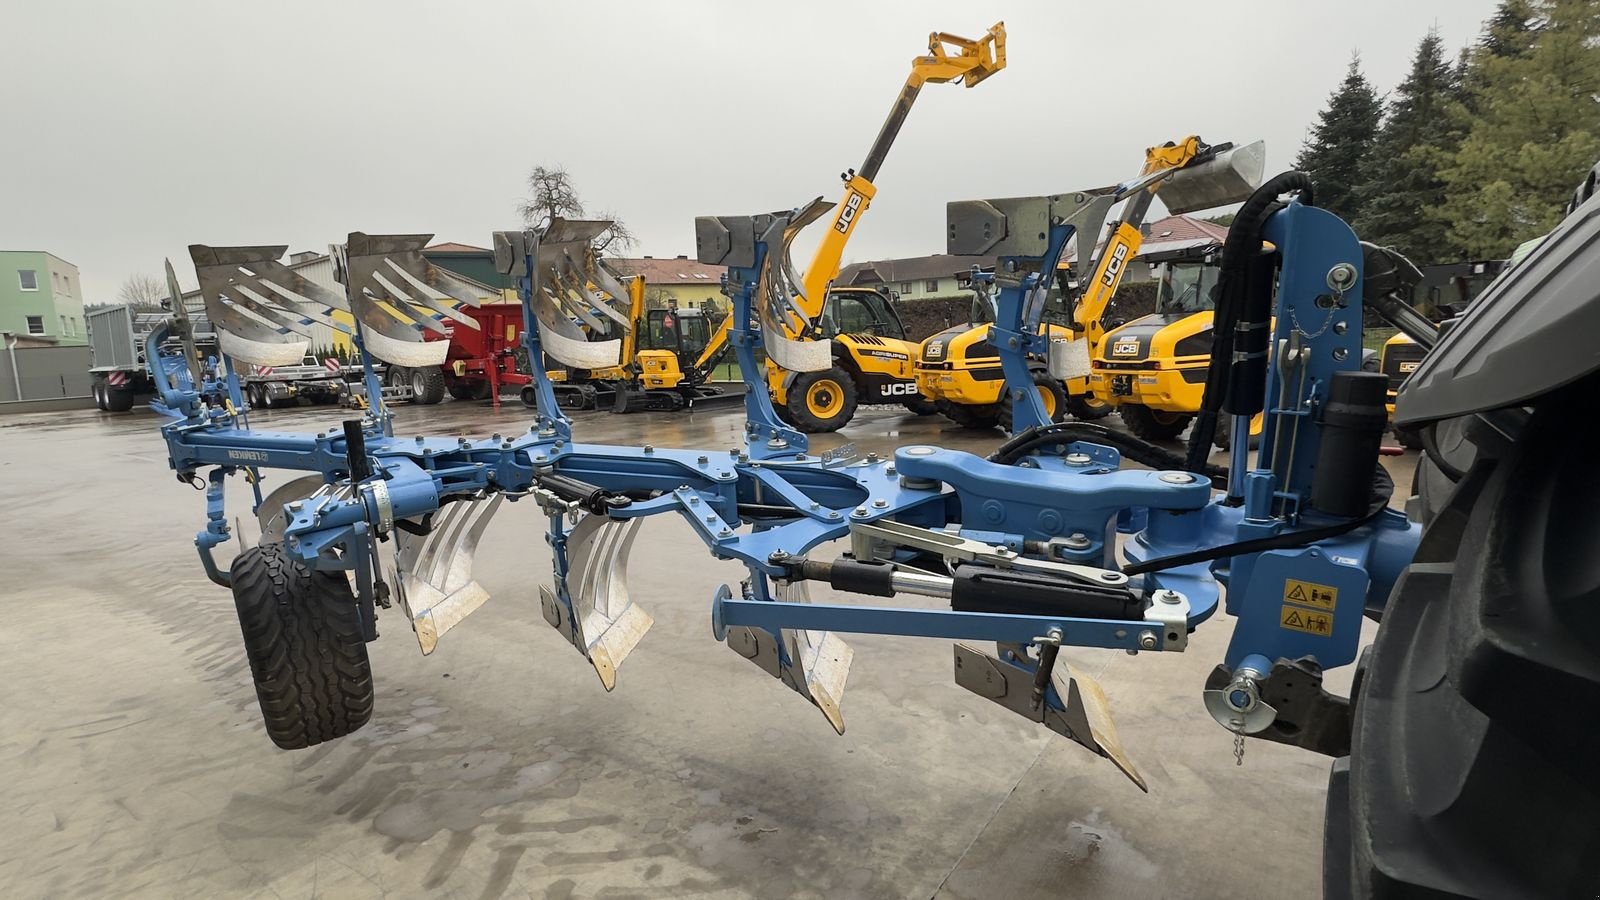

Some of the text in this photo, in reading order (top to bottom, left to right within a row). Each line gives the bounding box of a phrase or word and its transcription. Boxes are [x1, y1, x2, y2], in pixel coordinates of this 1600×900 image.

[836, 193, 862, 233] JCB
[1103, 243, 1128, 286] JCB
[1115, 344, 1137, 353] JCB
[881, 383, 918, 396] JCB
[228, 450, 261, 461] LEMKEN
